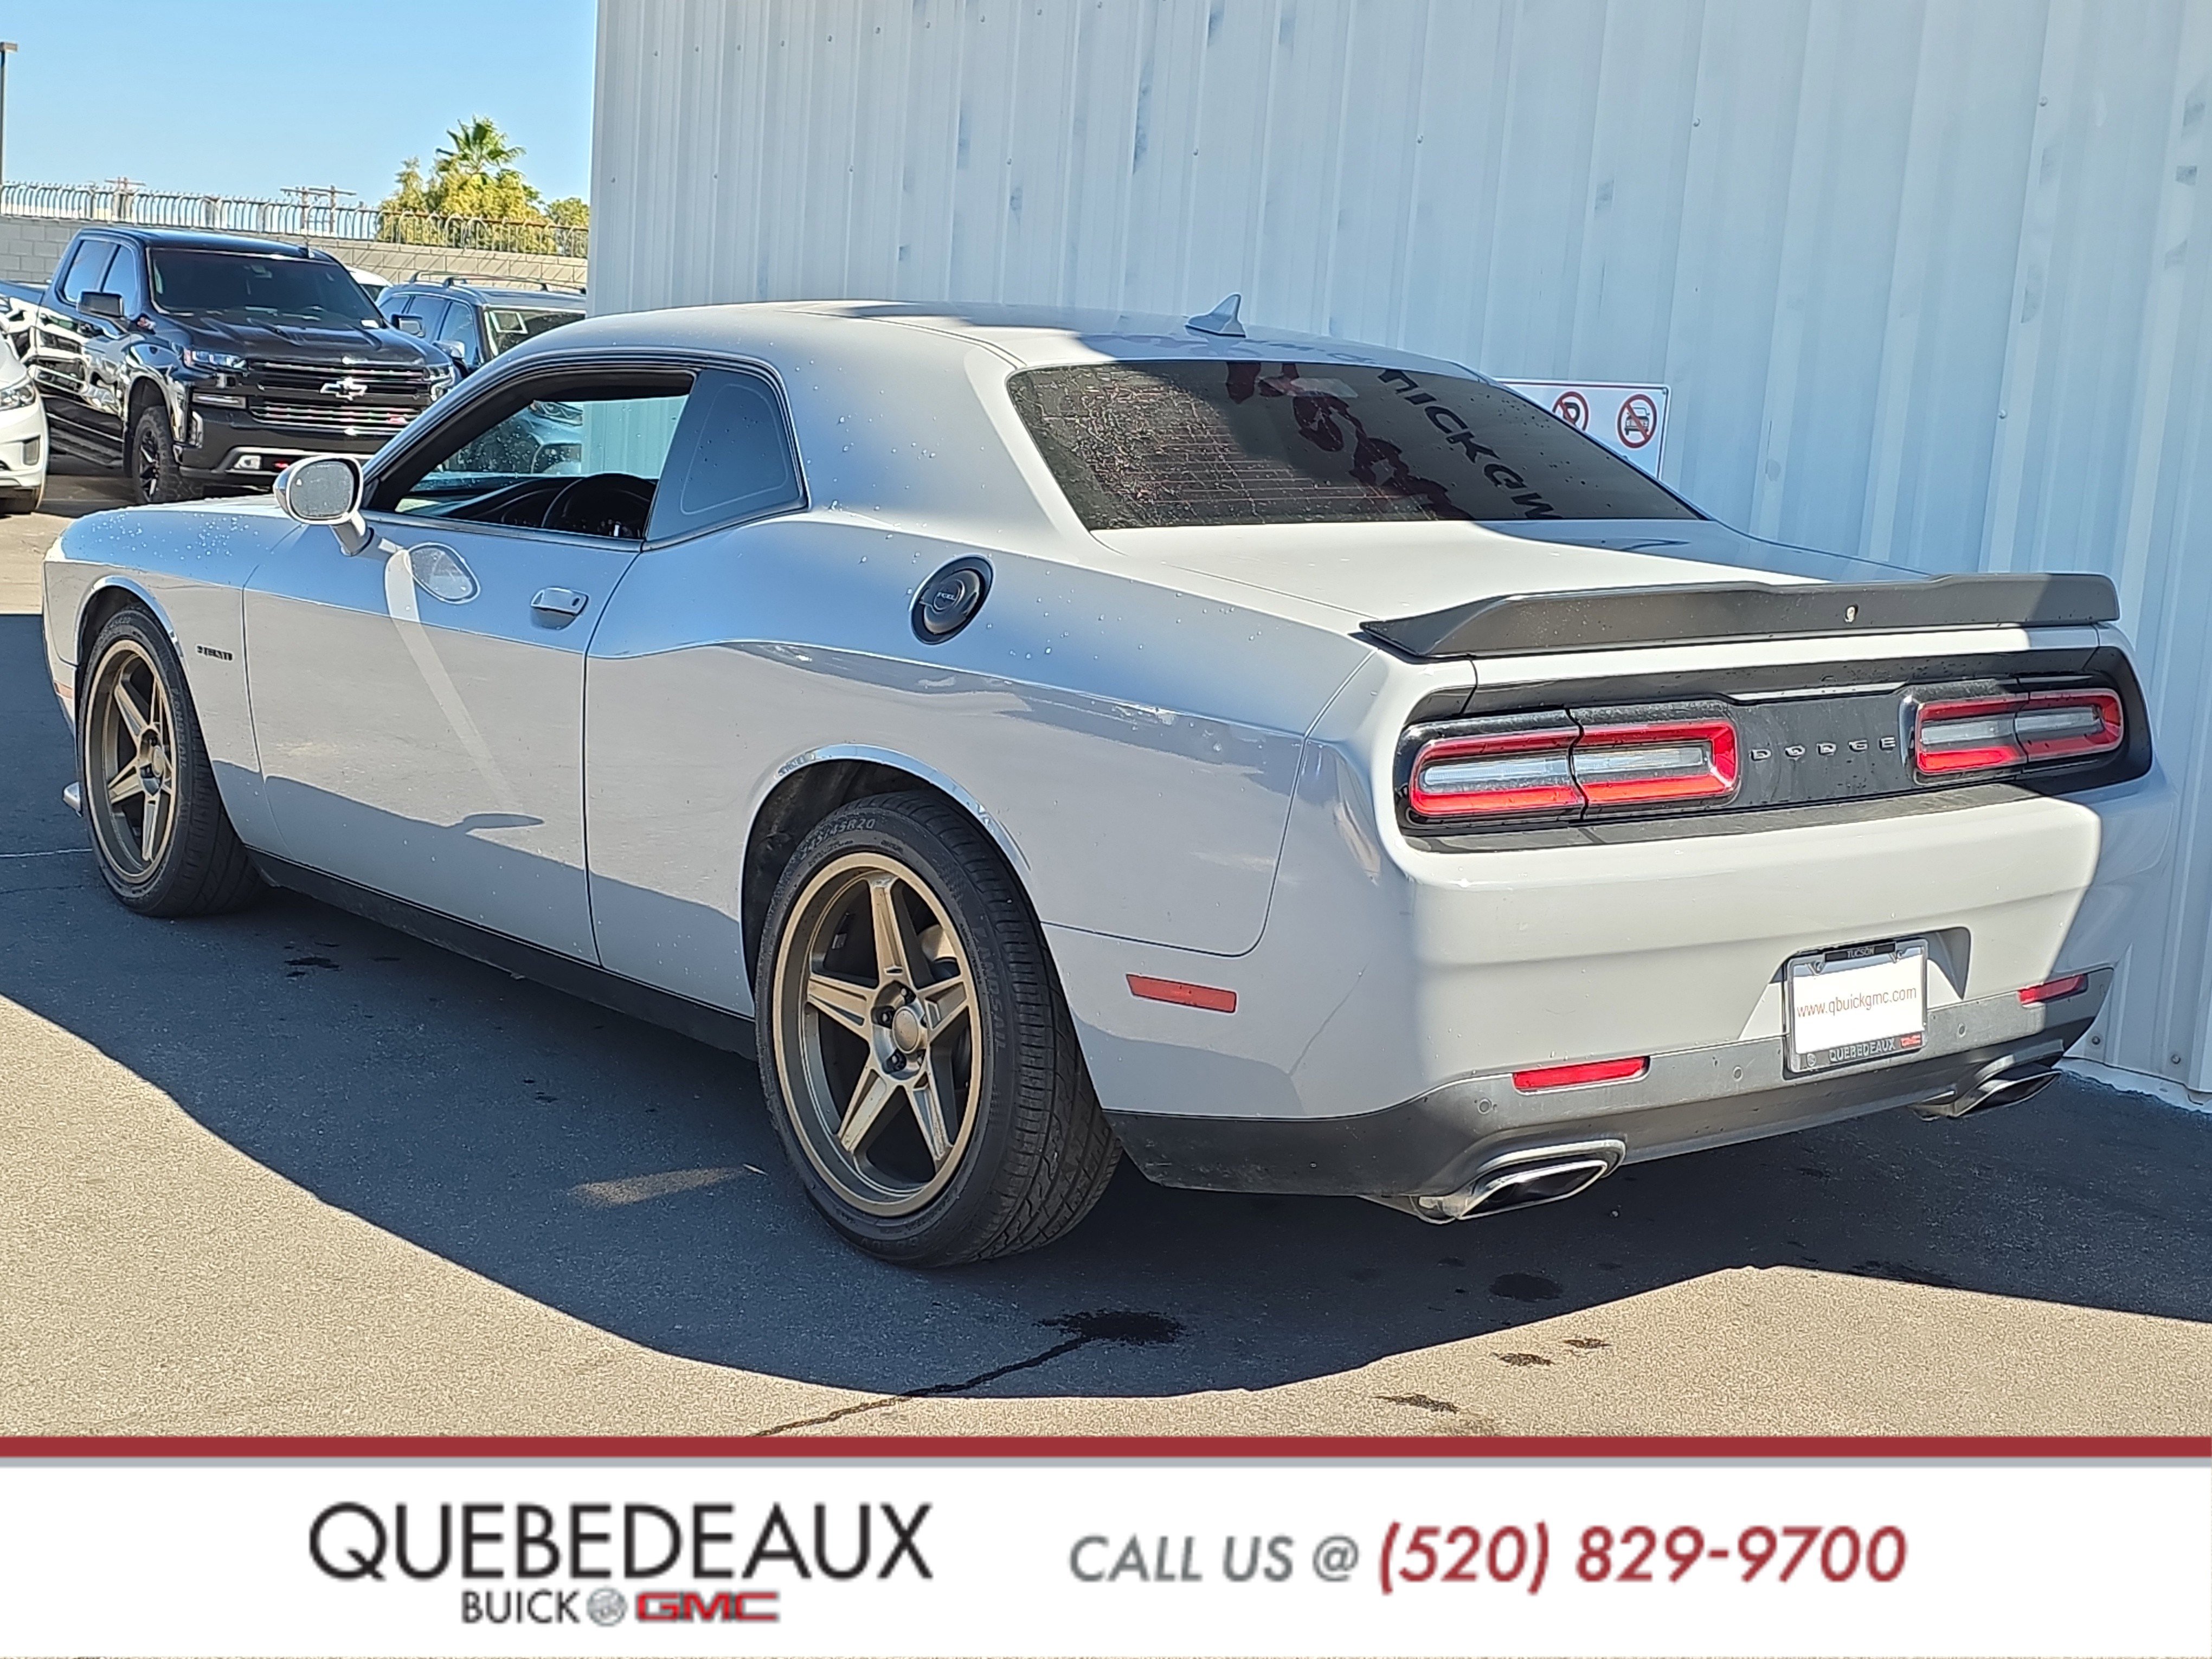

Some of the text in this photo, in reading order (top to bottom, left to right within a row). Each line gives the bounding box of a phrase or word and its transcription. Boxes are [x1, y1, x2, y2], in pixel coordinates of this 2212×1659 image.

[1750, 736, 1896, 762] DODGE
[1847, 947, 1875, 959] TUCSON
[1797, 987, 1917, 1018] www.qbuickgmc.com
[1829, 1037, 1896, 1063] QUEBEDEAUX
